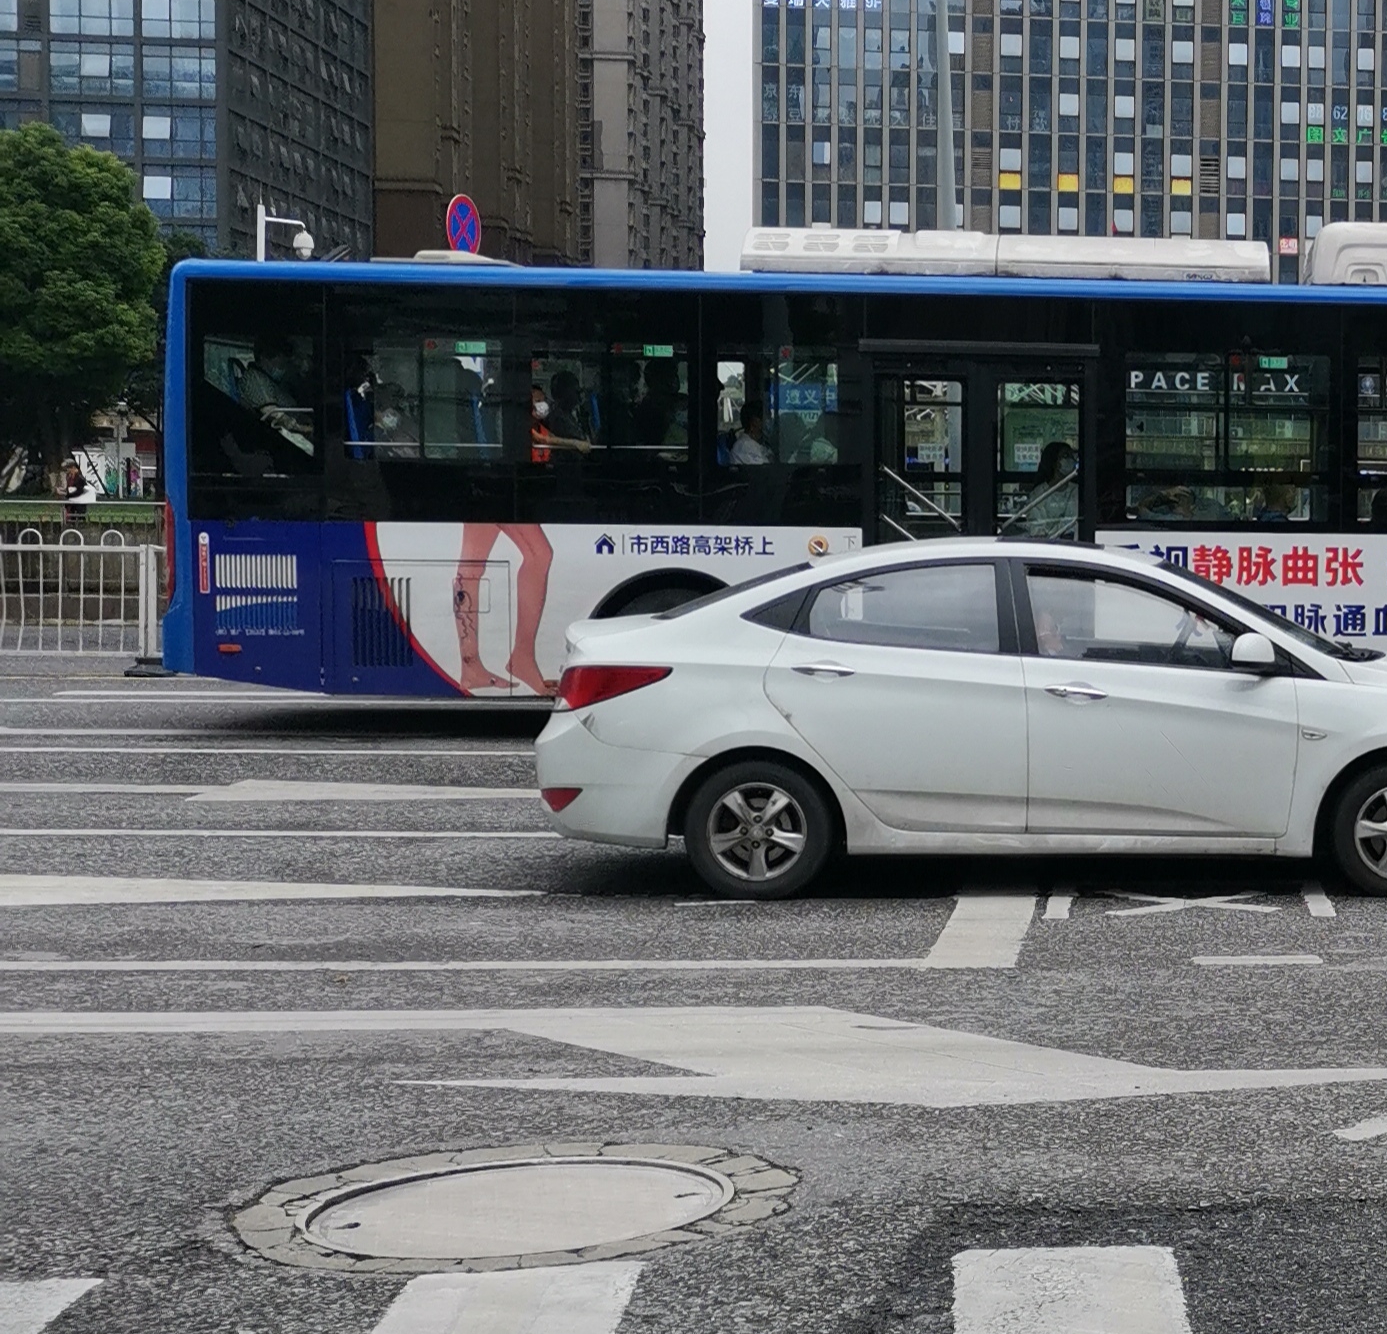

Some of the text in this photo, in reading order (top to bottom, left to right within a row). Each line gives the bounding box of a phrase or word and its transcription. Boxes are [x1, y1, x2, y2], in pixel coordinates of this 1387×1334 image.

[1130, 370, 1210, 391] PACE
[629, 534, 775, 556] 市西路高架桥上
